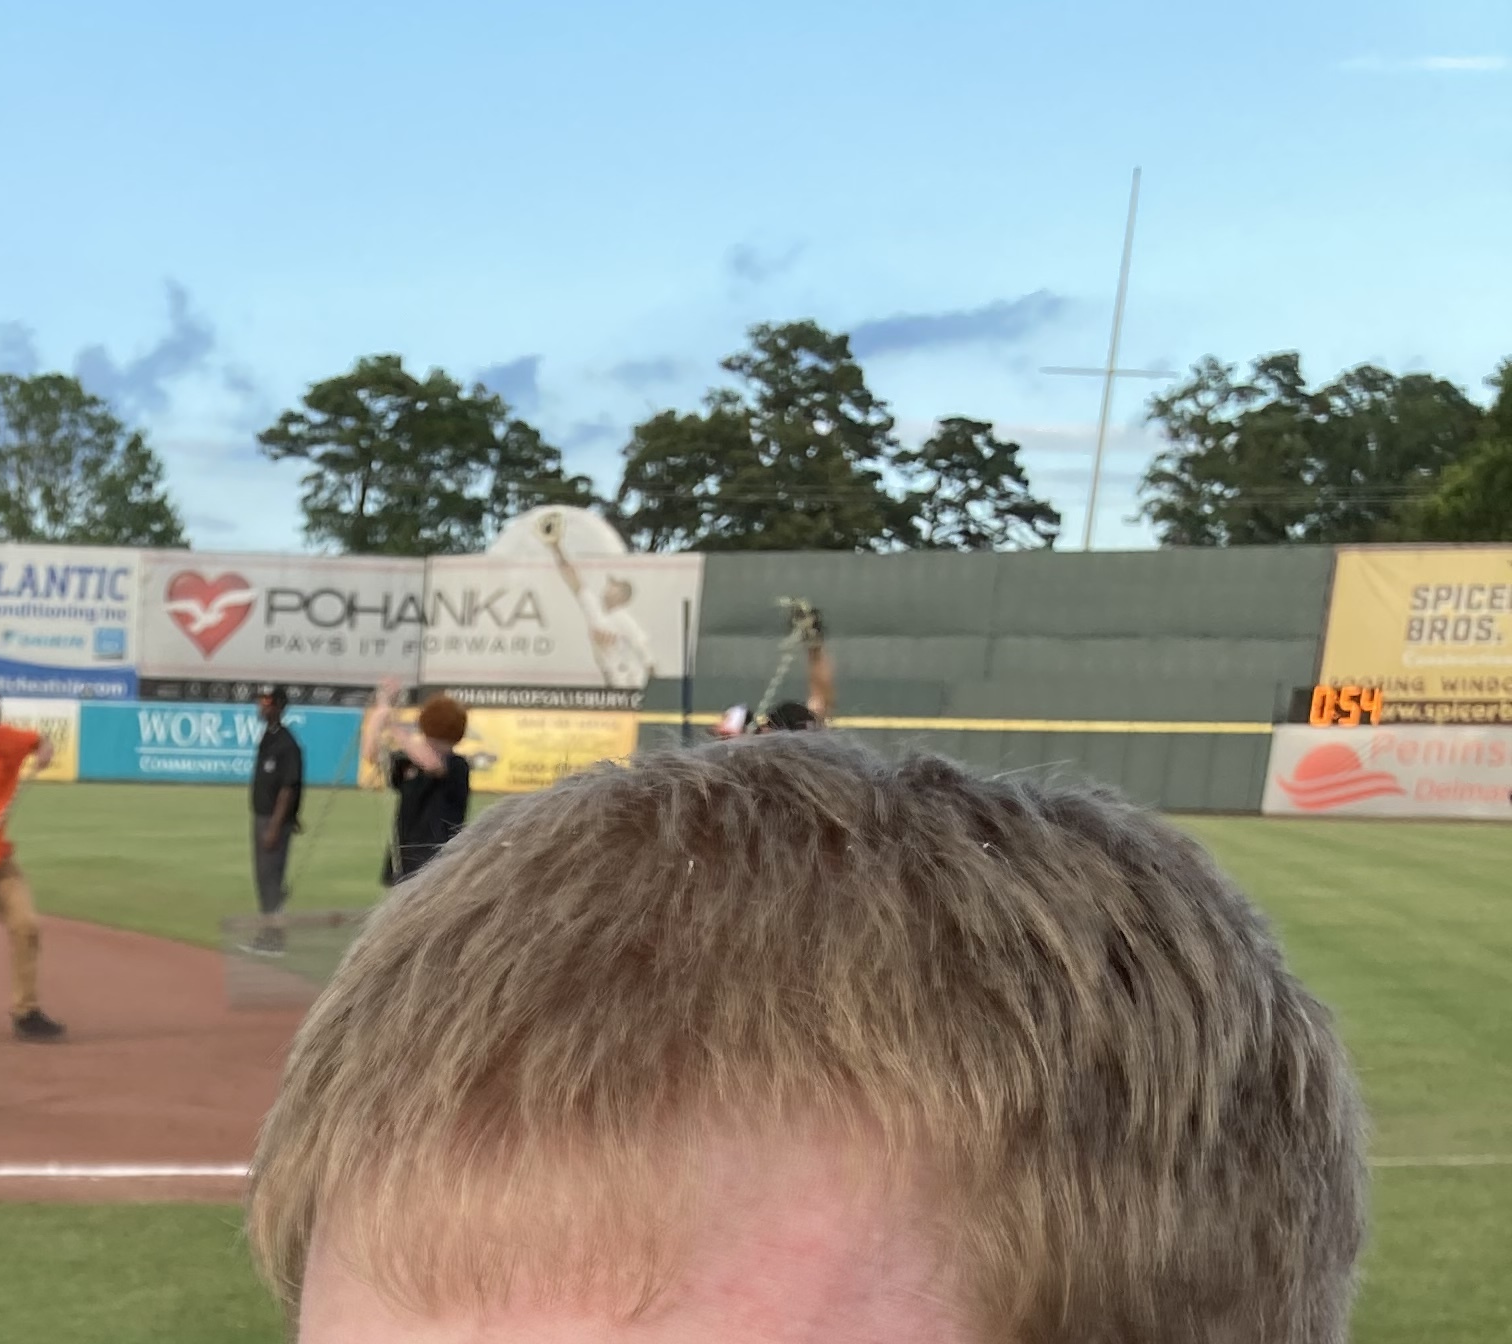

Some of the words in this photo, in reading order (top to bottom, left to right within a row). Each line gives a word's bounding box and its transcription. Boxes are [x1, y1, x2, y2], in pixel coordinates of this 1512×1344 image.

[264, 587, 549, 632] POHANKA
[1411, 584, 1512, 611] SPICE
[1406, 616, 1502, 643] BROS.
[264, 633, 347, 656] PAYS
[359, 637, 388, 657] IT
[401, 636, 555, 659] FORWARD
